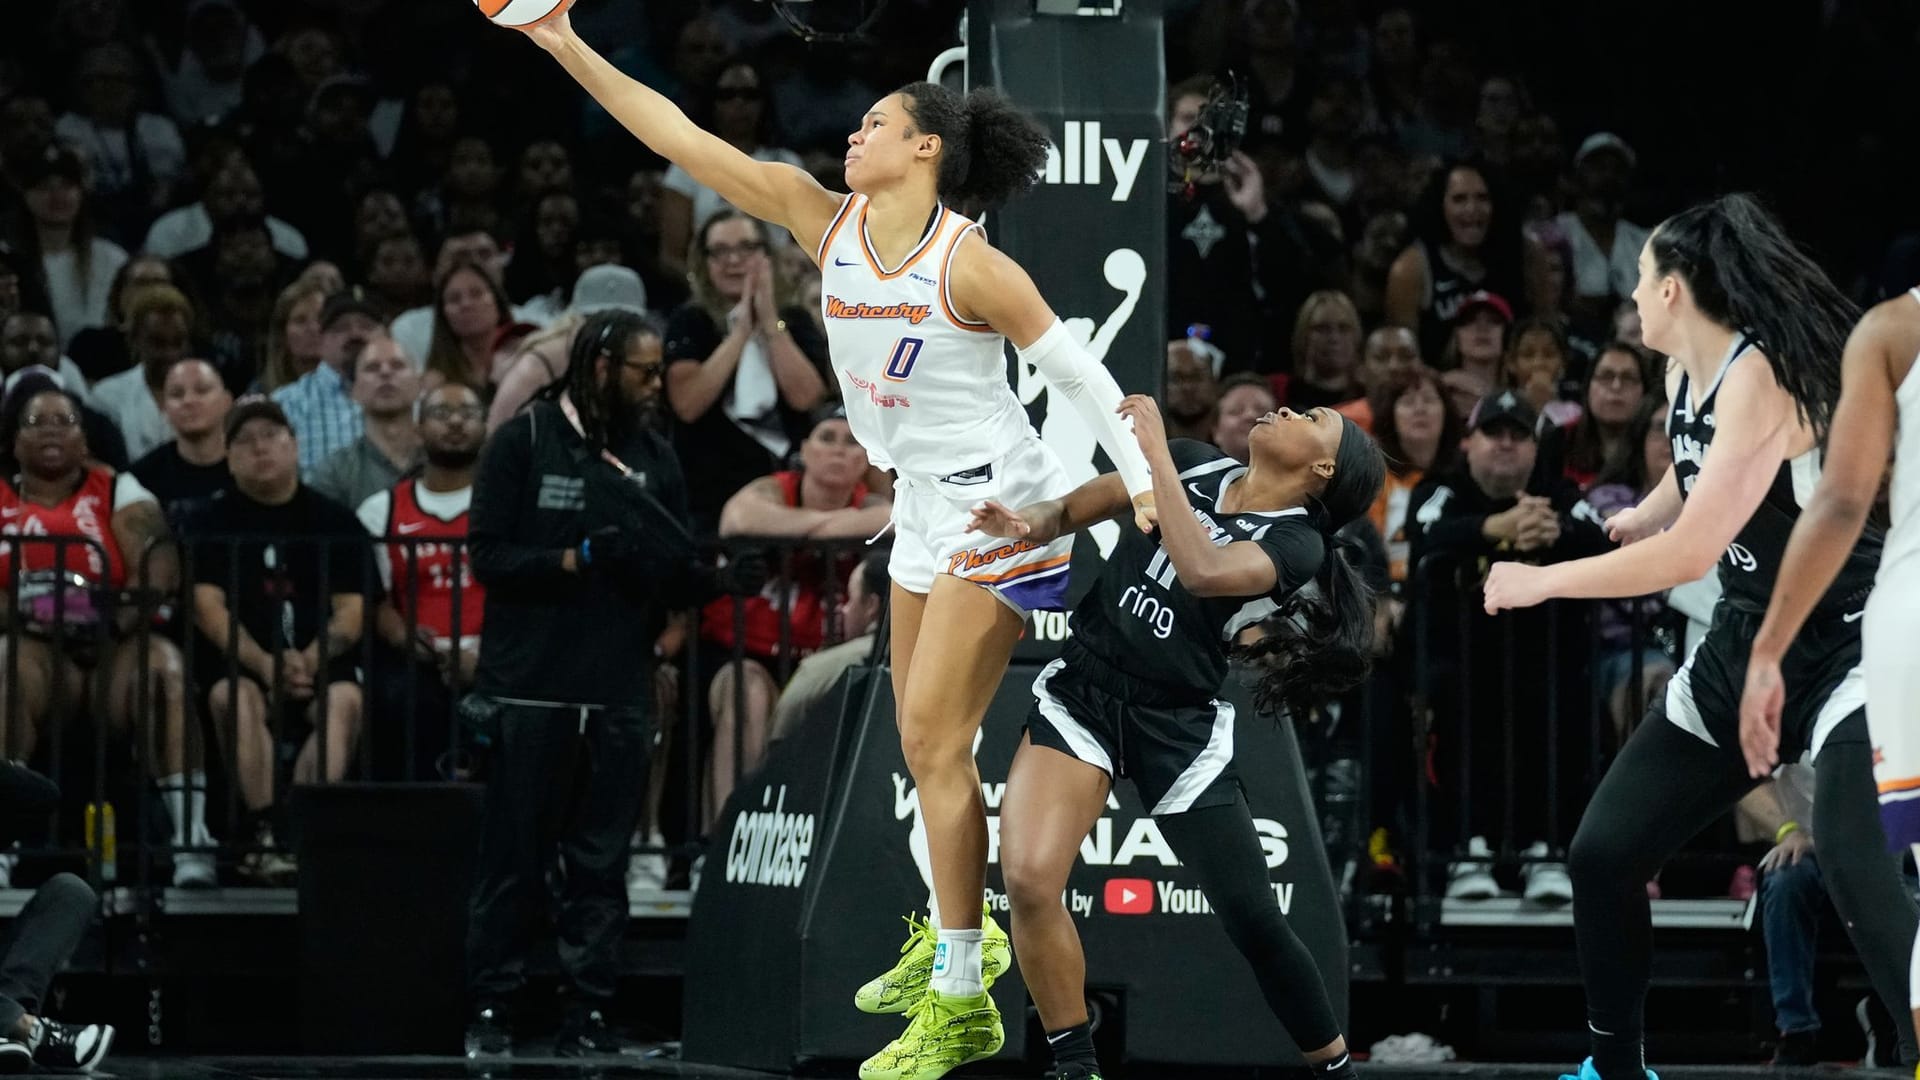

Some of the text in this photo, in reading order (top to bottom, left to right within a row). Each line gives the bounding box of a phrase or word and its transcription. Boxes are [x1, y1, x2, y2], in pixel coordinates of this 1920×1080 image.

[826, 295, 932, 324] Mercury
[883, 337, 925, 382] 0
[948, 540, 1049, 575] Phoen
[1118, 585, 1174, 639] ring
[725, 783, 815, 888] coinbase
[1072, 889, 1093, 918] by
